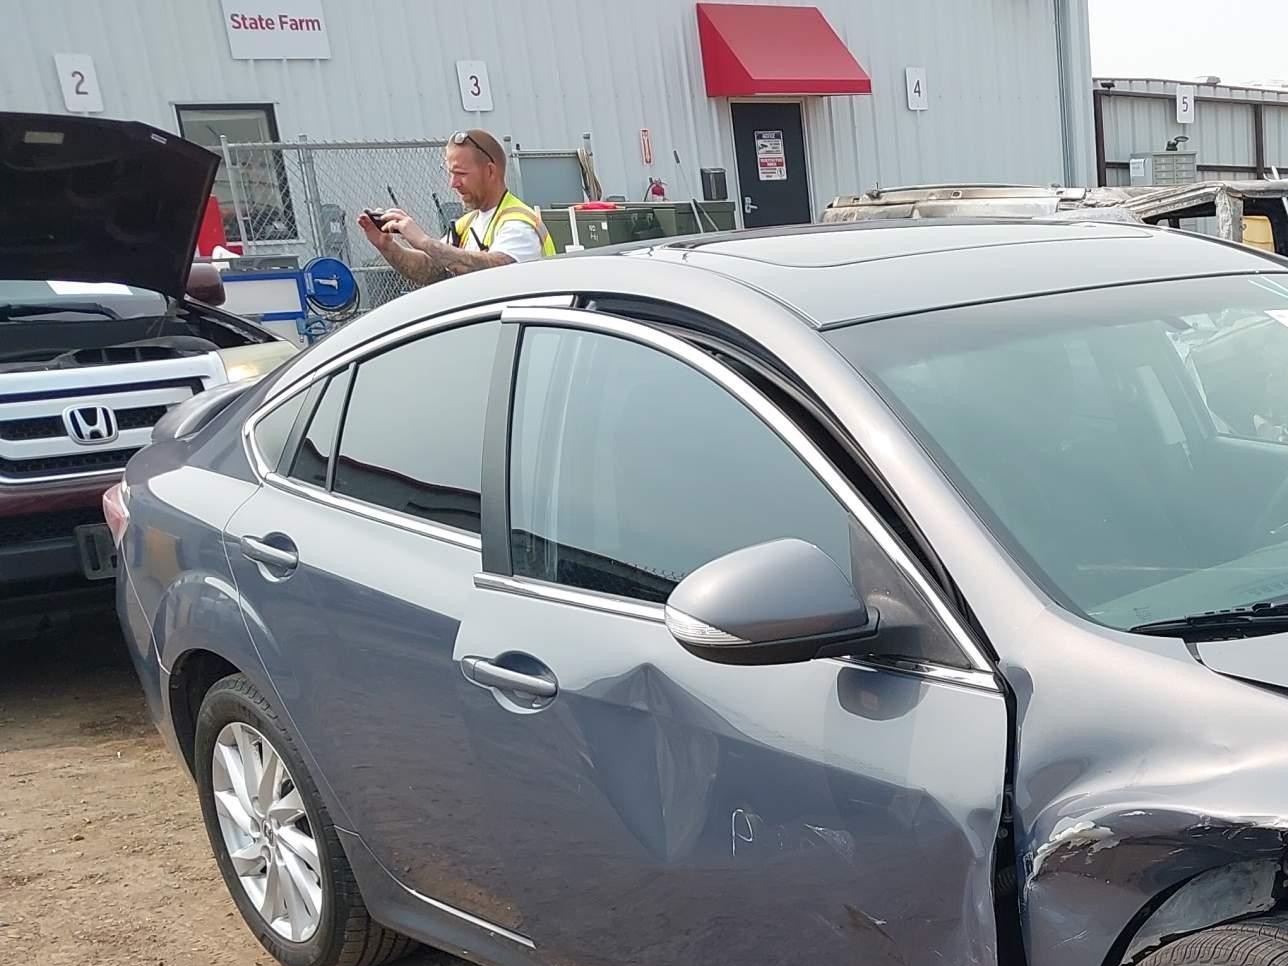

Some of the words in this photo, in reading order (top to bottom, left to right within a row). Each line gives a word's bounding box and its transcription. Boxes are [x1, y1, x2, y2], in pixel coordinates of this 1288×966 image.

[230, 13, 275, 30] State
[279, 14, 321, 31] Farm
[71, 70, 89, 95] 2
[469, 75, 481, 96] 3
[913, 79, 921, 97] 4
[1182, 96, 1189, 112] 5
